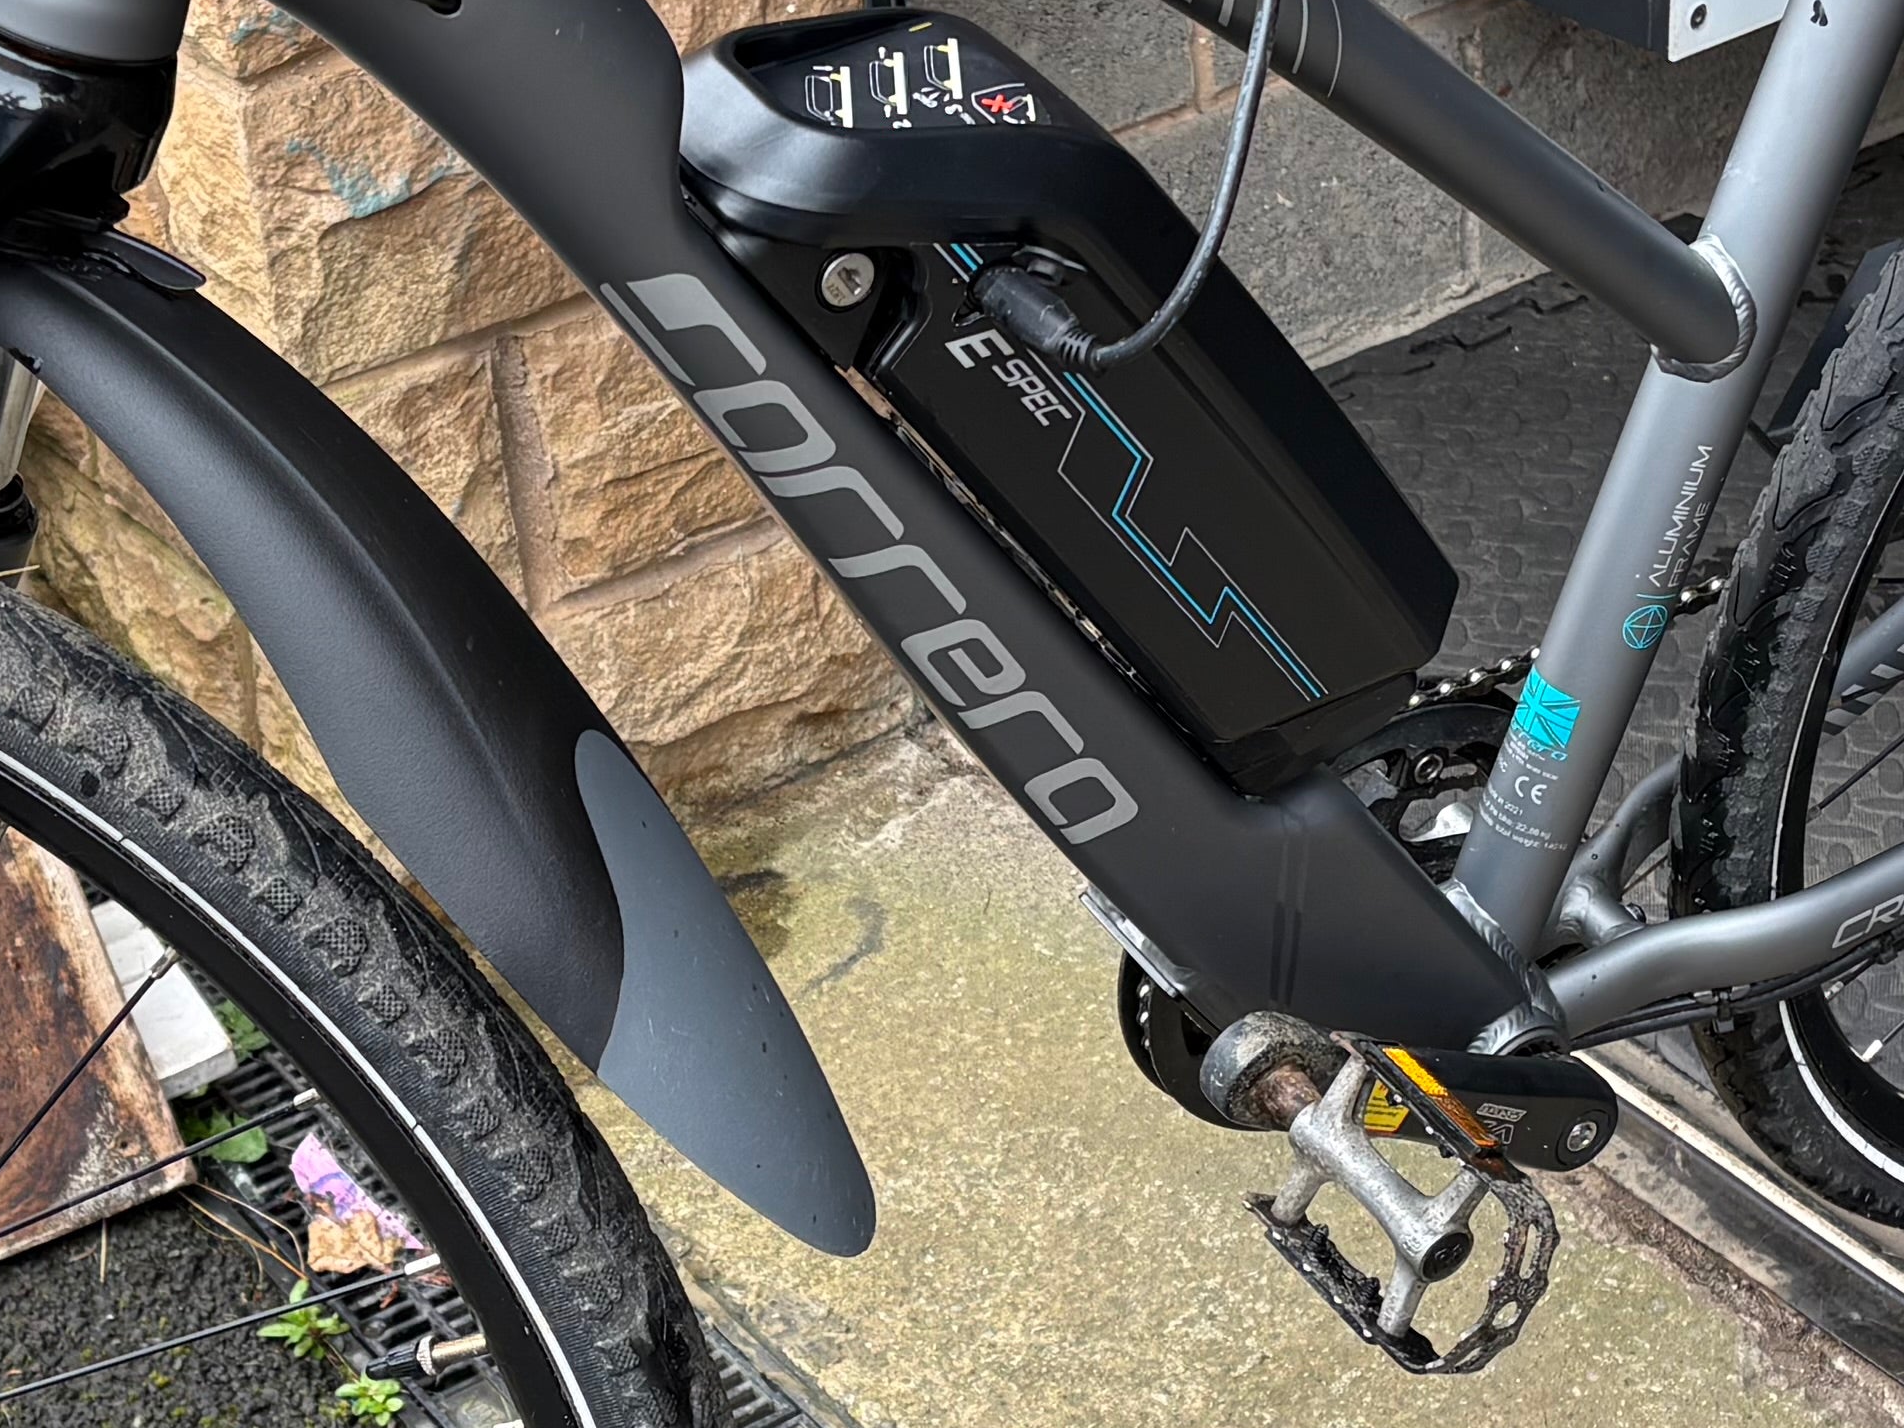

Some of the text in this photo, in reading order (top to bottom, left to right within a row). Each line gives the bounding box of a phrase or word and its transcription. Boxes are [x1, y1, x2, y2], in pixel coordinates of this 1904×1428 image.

[944, 329, 1083, 428] E SPEC
[1647, 444, 1714, 588] ALUMINIUM
